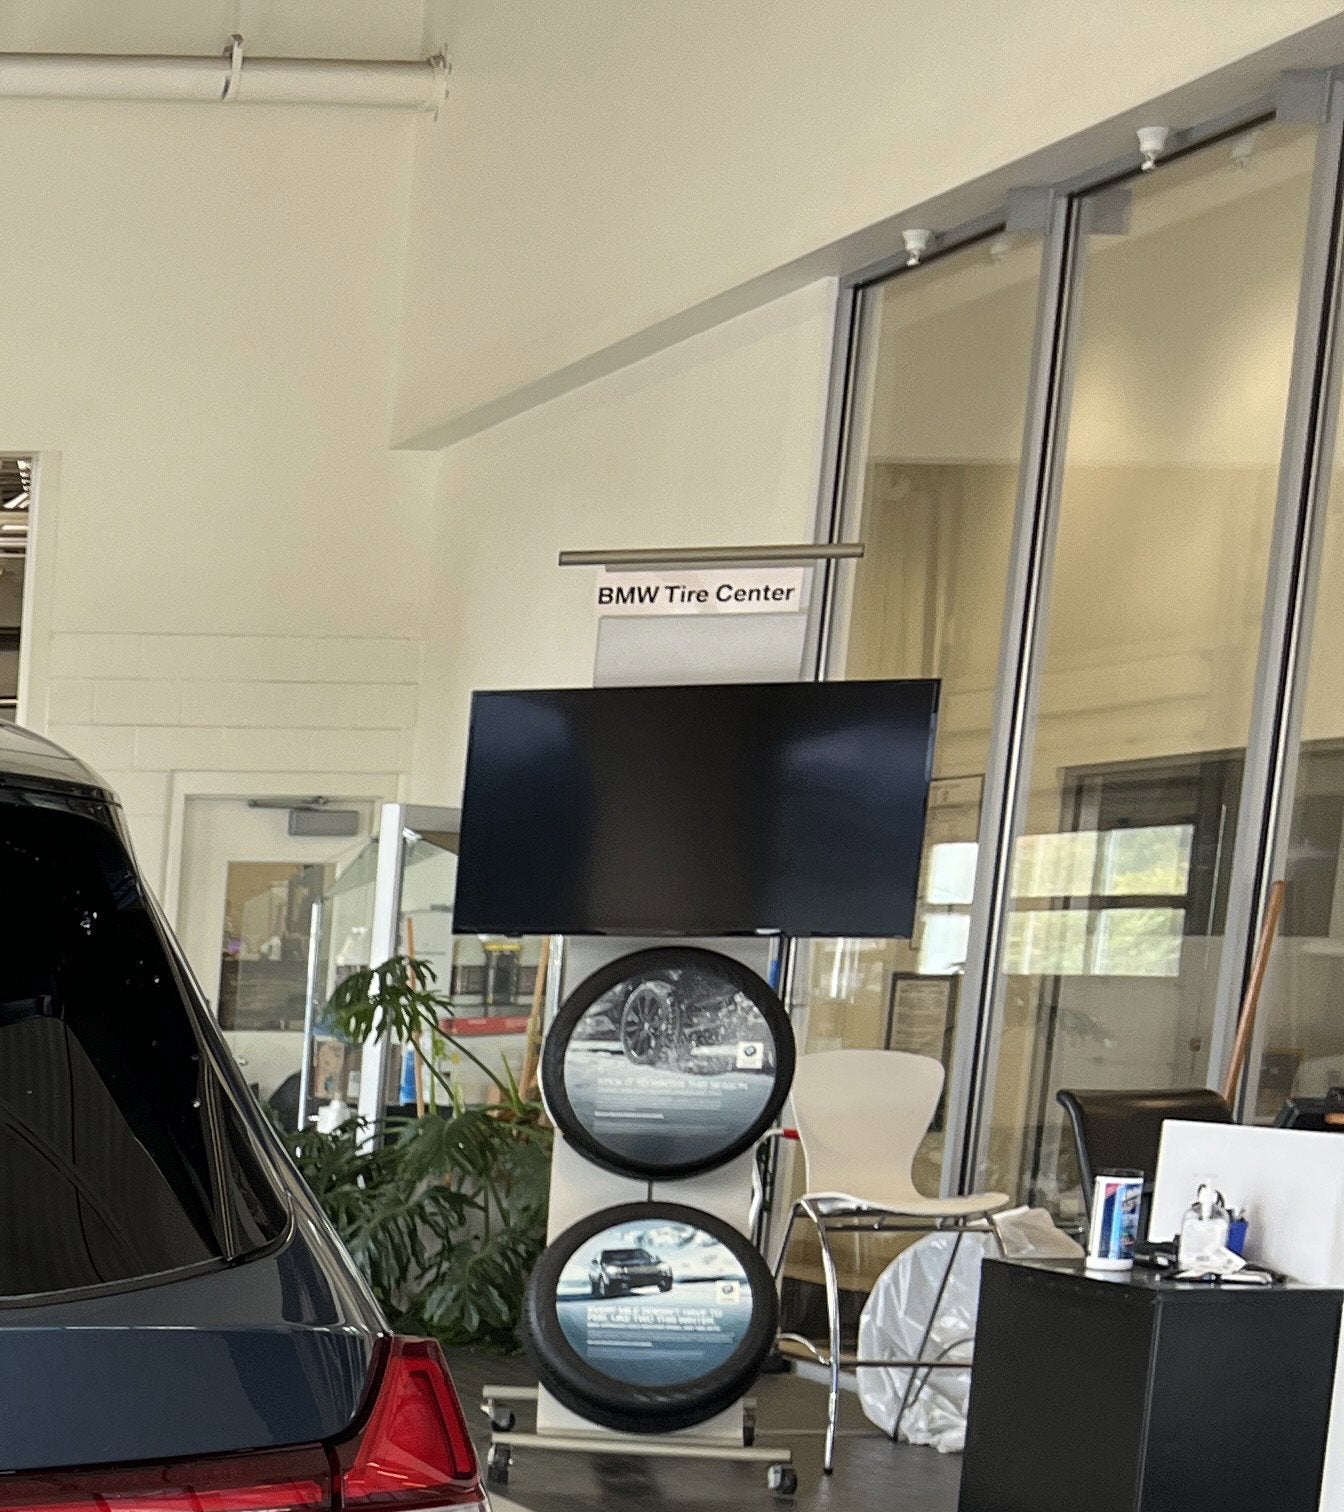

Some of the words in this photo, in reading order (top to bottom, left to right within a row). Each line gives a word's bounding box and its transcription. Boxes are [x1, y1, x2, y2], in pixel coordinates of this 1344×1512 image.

[598, 586, 660, 605] BMW
[665, 584, 709, 603] Tire
[715, 583, 796, 602] Center
